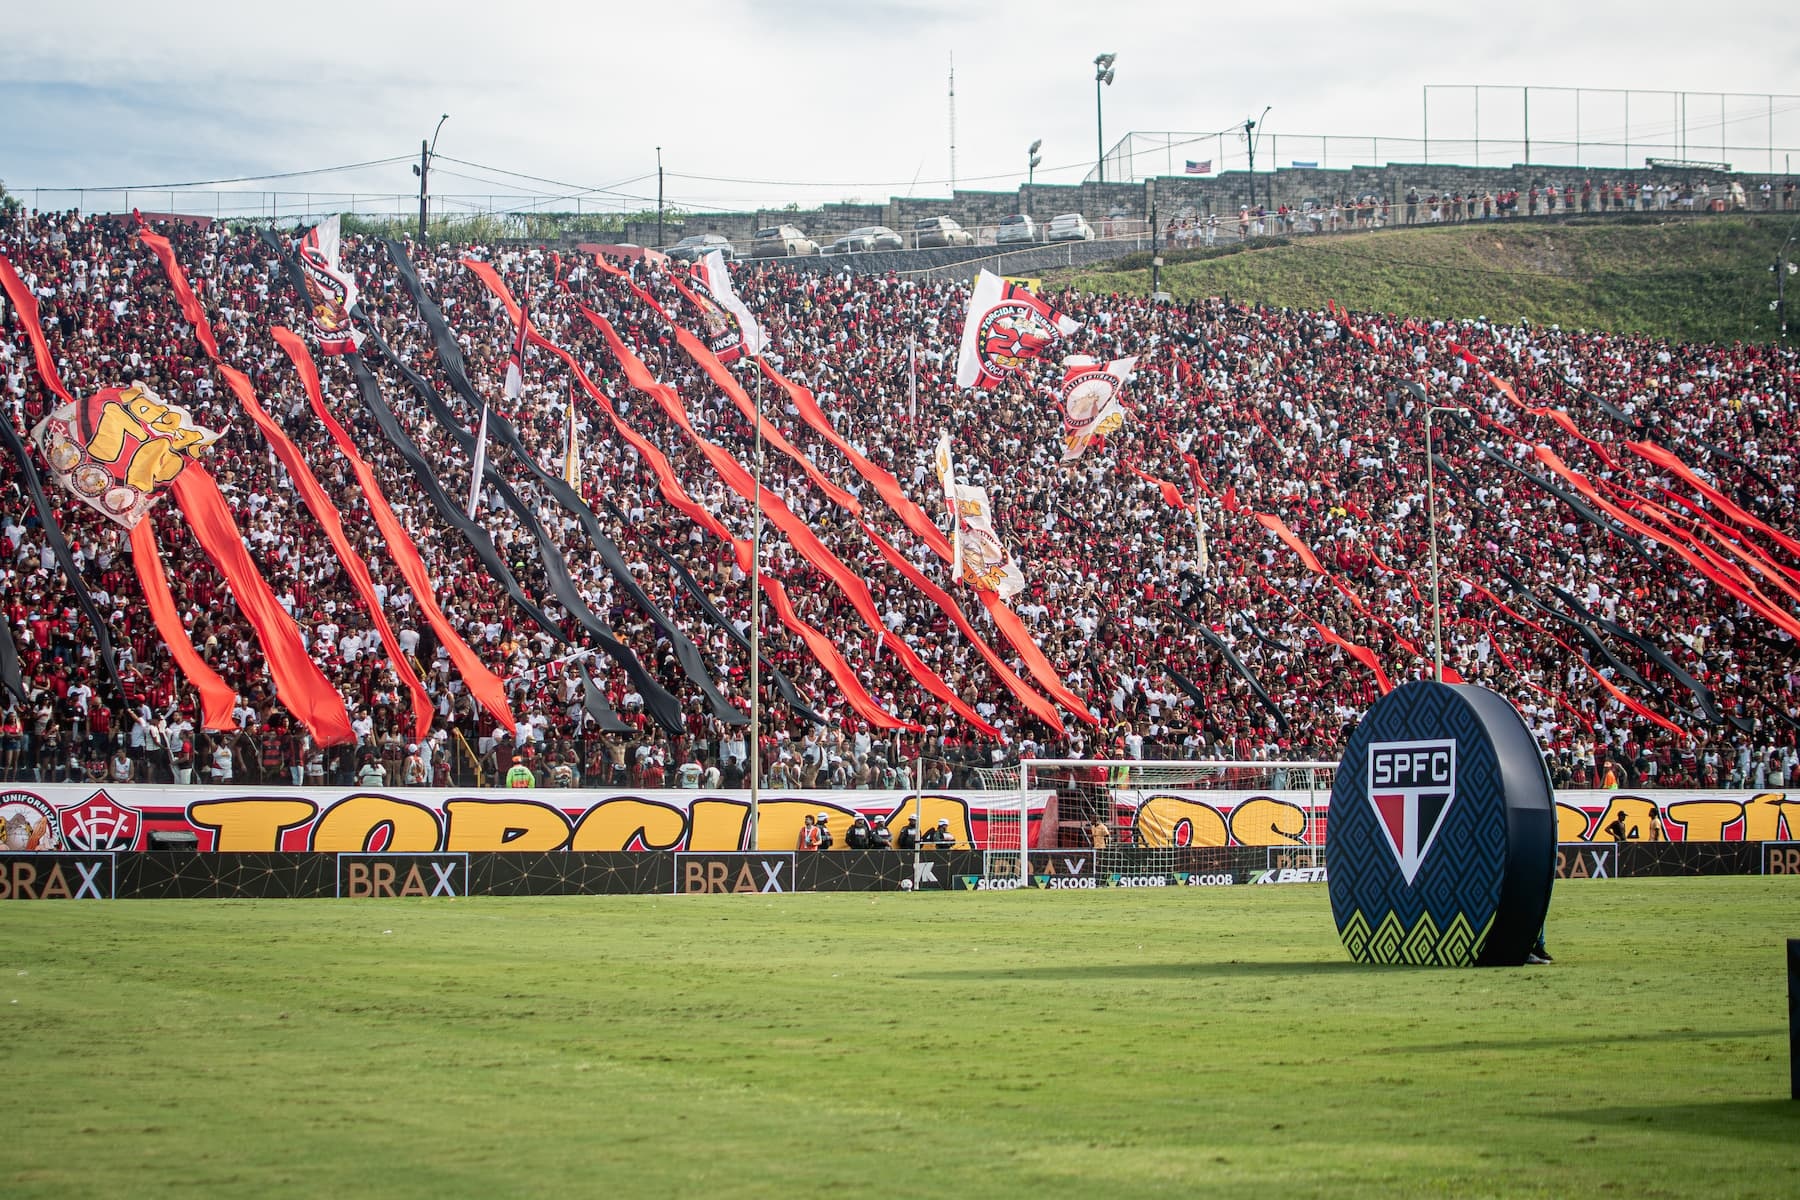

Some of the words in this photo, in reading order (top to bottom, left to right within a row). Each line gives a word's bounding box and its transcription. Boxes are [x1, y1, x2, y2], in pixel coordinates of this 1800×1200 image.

[1375, 751, 1449, 784] SPFC
[685, 861, 784, 893] BRAX
[1557, 850, 1610, 879] RAX
[350, 862, 457, 897] BRAX
[1050, 877, 1097, 889] SICOOB
[1120, 875, 1166, 888] SICOOB
[1189, 873, 1233, 886] SICOOB
